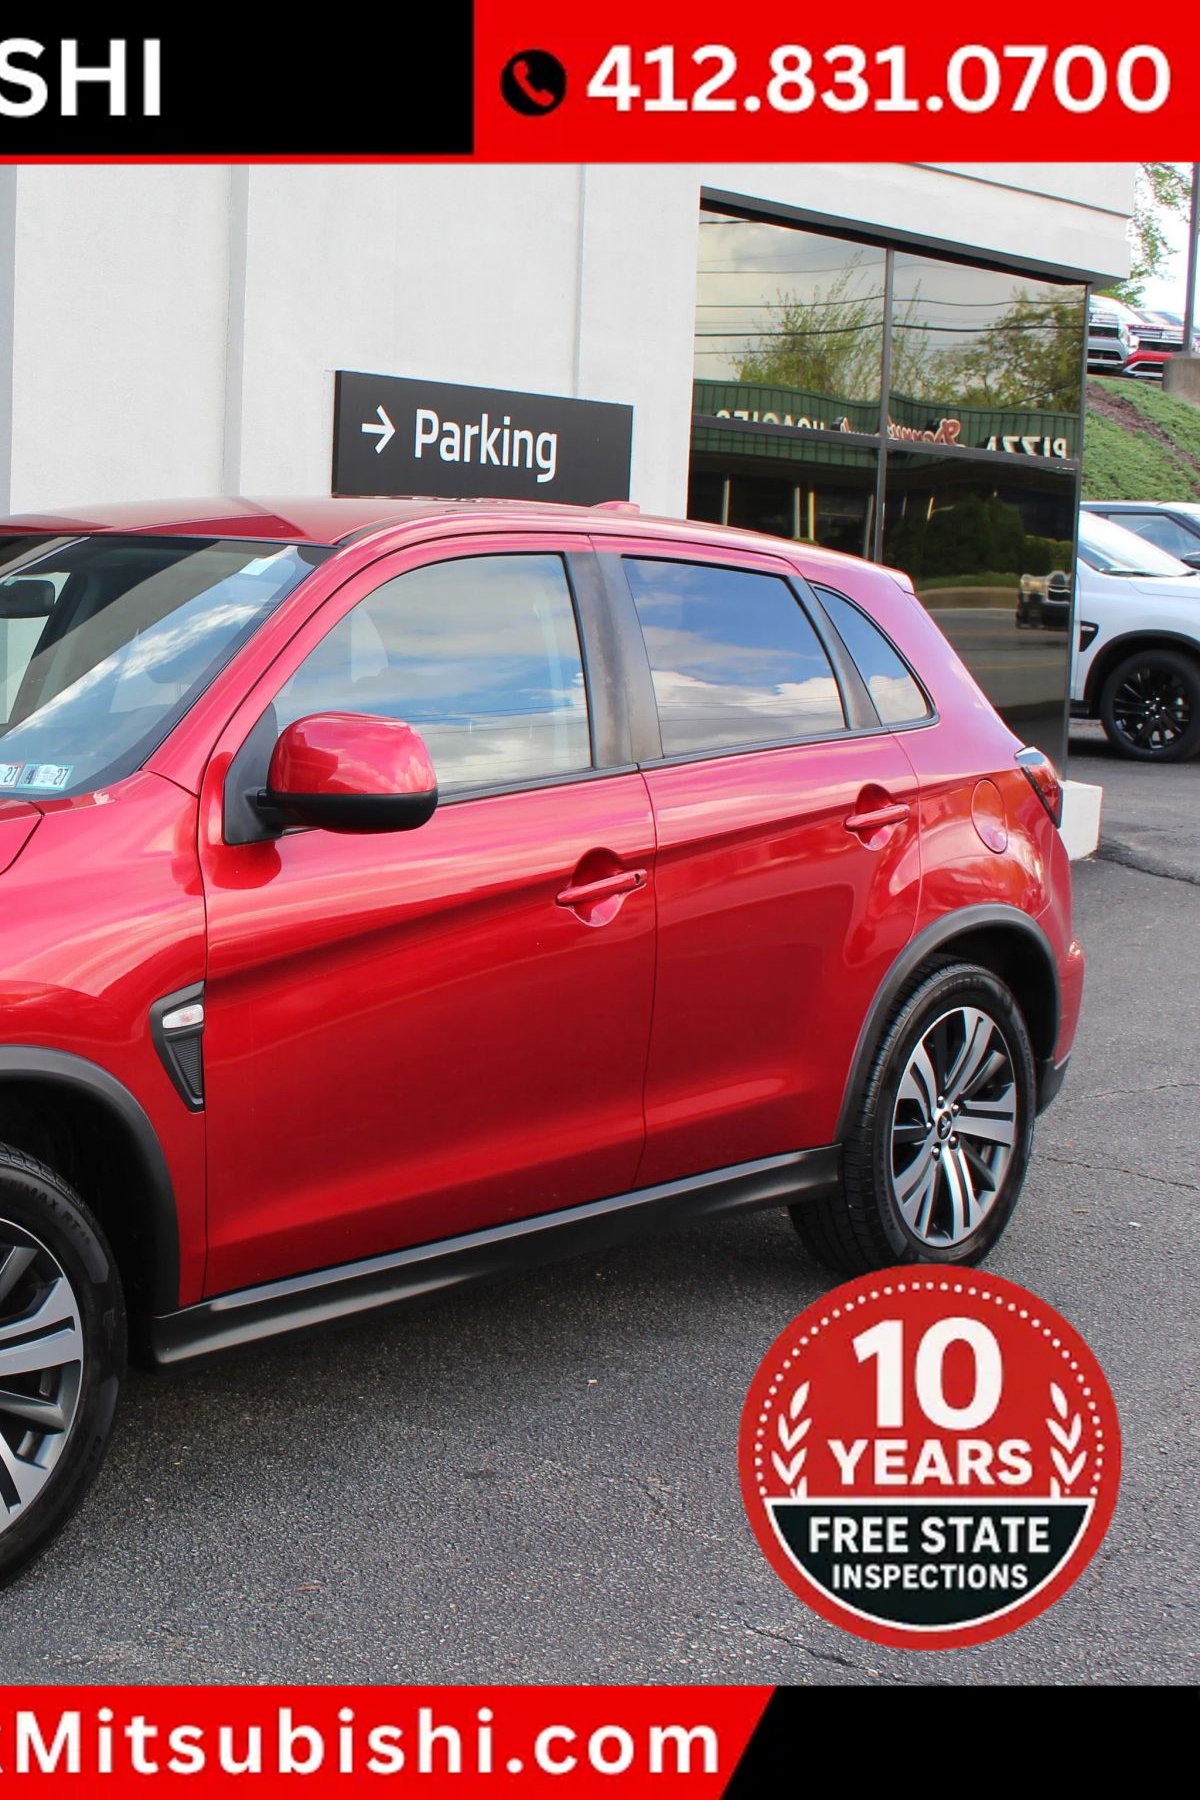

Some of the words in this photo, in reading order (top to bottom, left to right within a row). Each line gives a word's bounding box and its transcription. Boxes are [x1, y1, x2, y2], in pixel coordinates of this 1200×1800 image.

[414, 408, 558, 483] Parking
[3, 766, 19, 783] 27
[52, 767, 69, 785] 27
